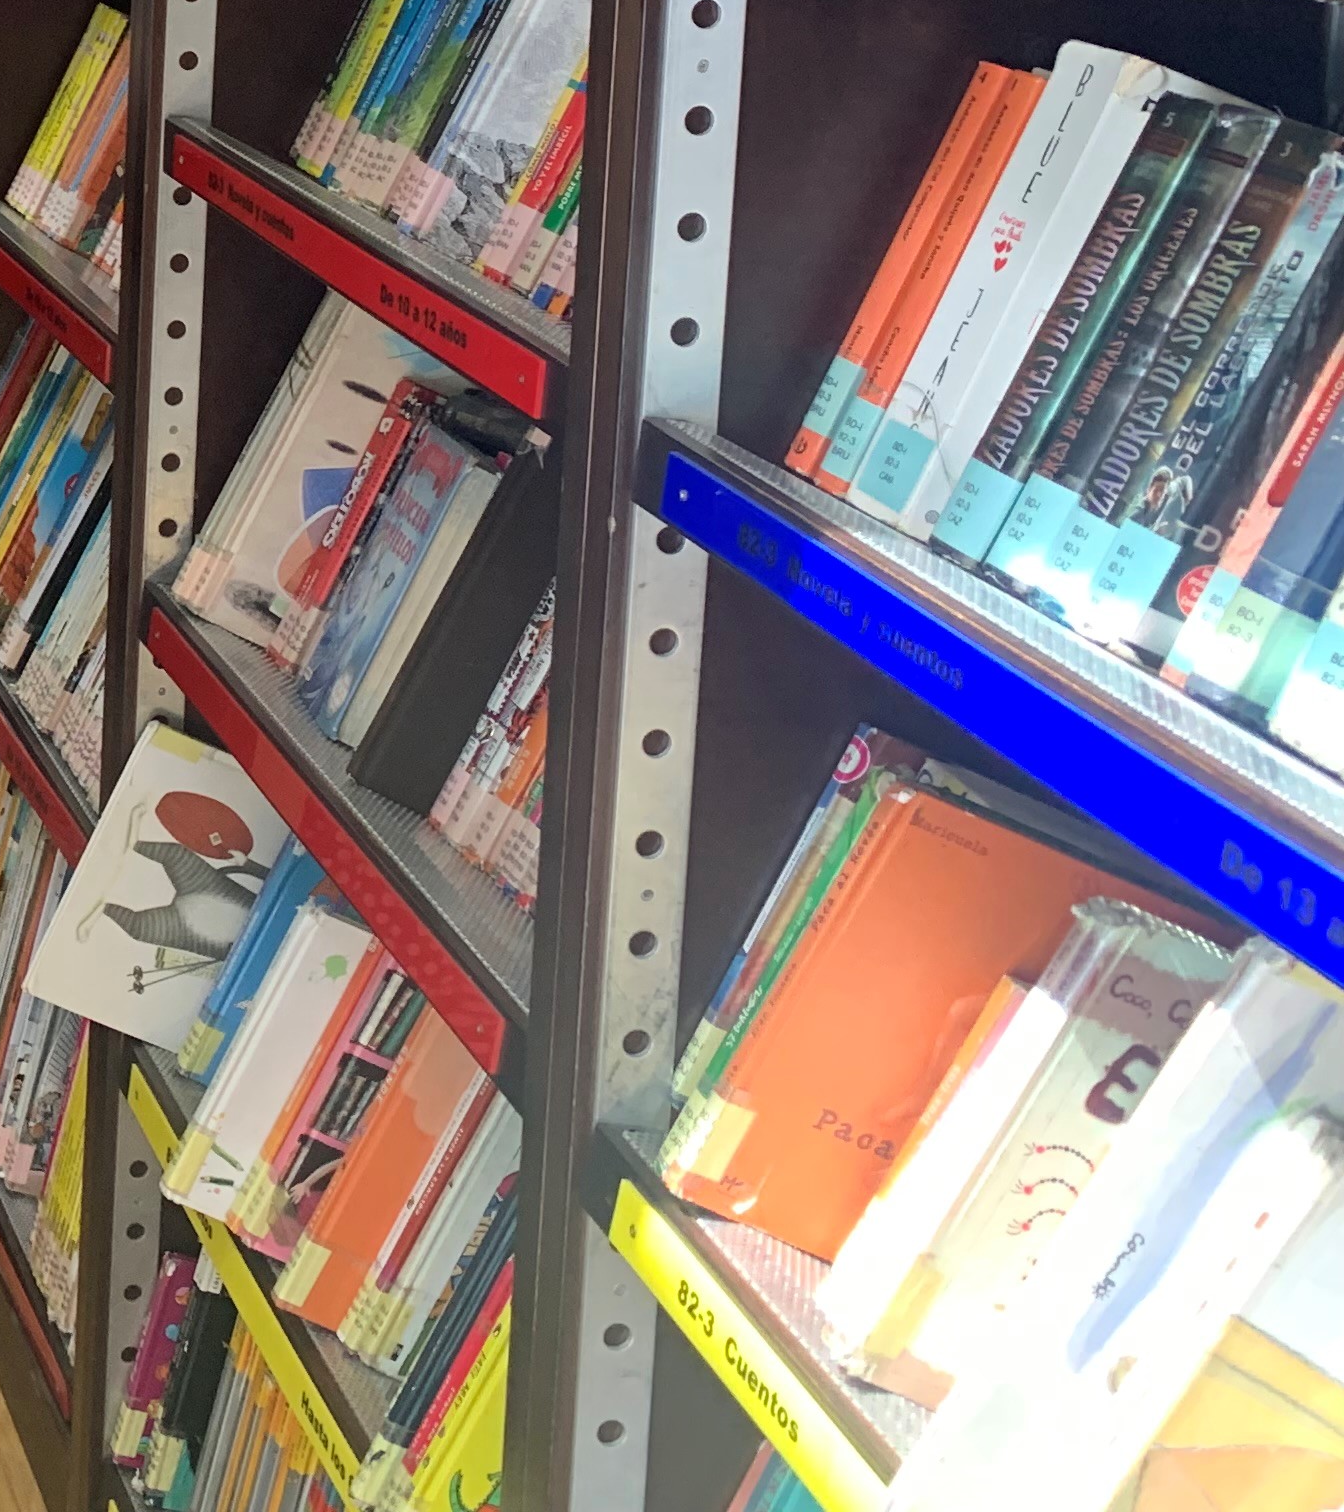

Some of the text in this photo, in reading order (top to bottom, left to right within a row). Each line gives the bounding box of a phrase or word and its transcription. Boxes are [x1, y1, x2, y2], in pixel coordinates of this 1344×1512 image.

[1162, 112, 1175, 128] 5
[542, 158, 554, 171] EL
[380, 282, 394, 306] De
[398, 295, 410, 317] 10
[413, 306, 420, 323] a
[423, 308, 437, 333] 12
[439, 320, 468, 350] años
[976, 185, 1154, 472] ZADORES DE SOMBRAS
[1059, 412, 1084, 440] DE
[1121, 291, 1151, 327] LOS
[1079, 214, 1271, 520] ZADORES DE SOMBRAS
[1170, 415, 1197, 451] EL
[1174, 417, 1214, 473] DEL
[1291, 425, 1320, 468] SARAH
[1008, 526, 1025, 542] CAZ
[1226, 623, 1253, 643] 82-3
[1221, 838, 1263, 894] De
[1278, 877, 1317, 926] 13
[807, 894, 836, 932] Paca
[1084, 1043, 1160, 1125] E
[811, 1108, 897, 1161] Paca
[676, 1279, 802, 1445] 82-3 Cuentos
[300, 1392, 348, 1477] Hasta los
